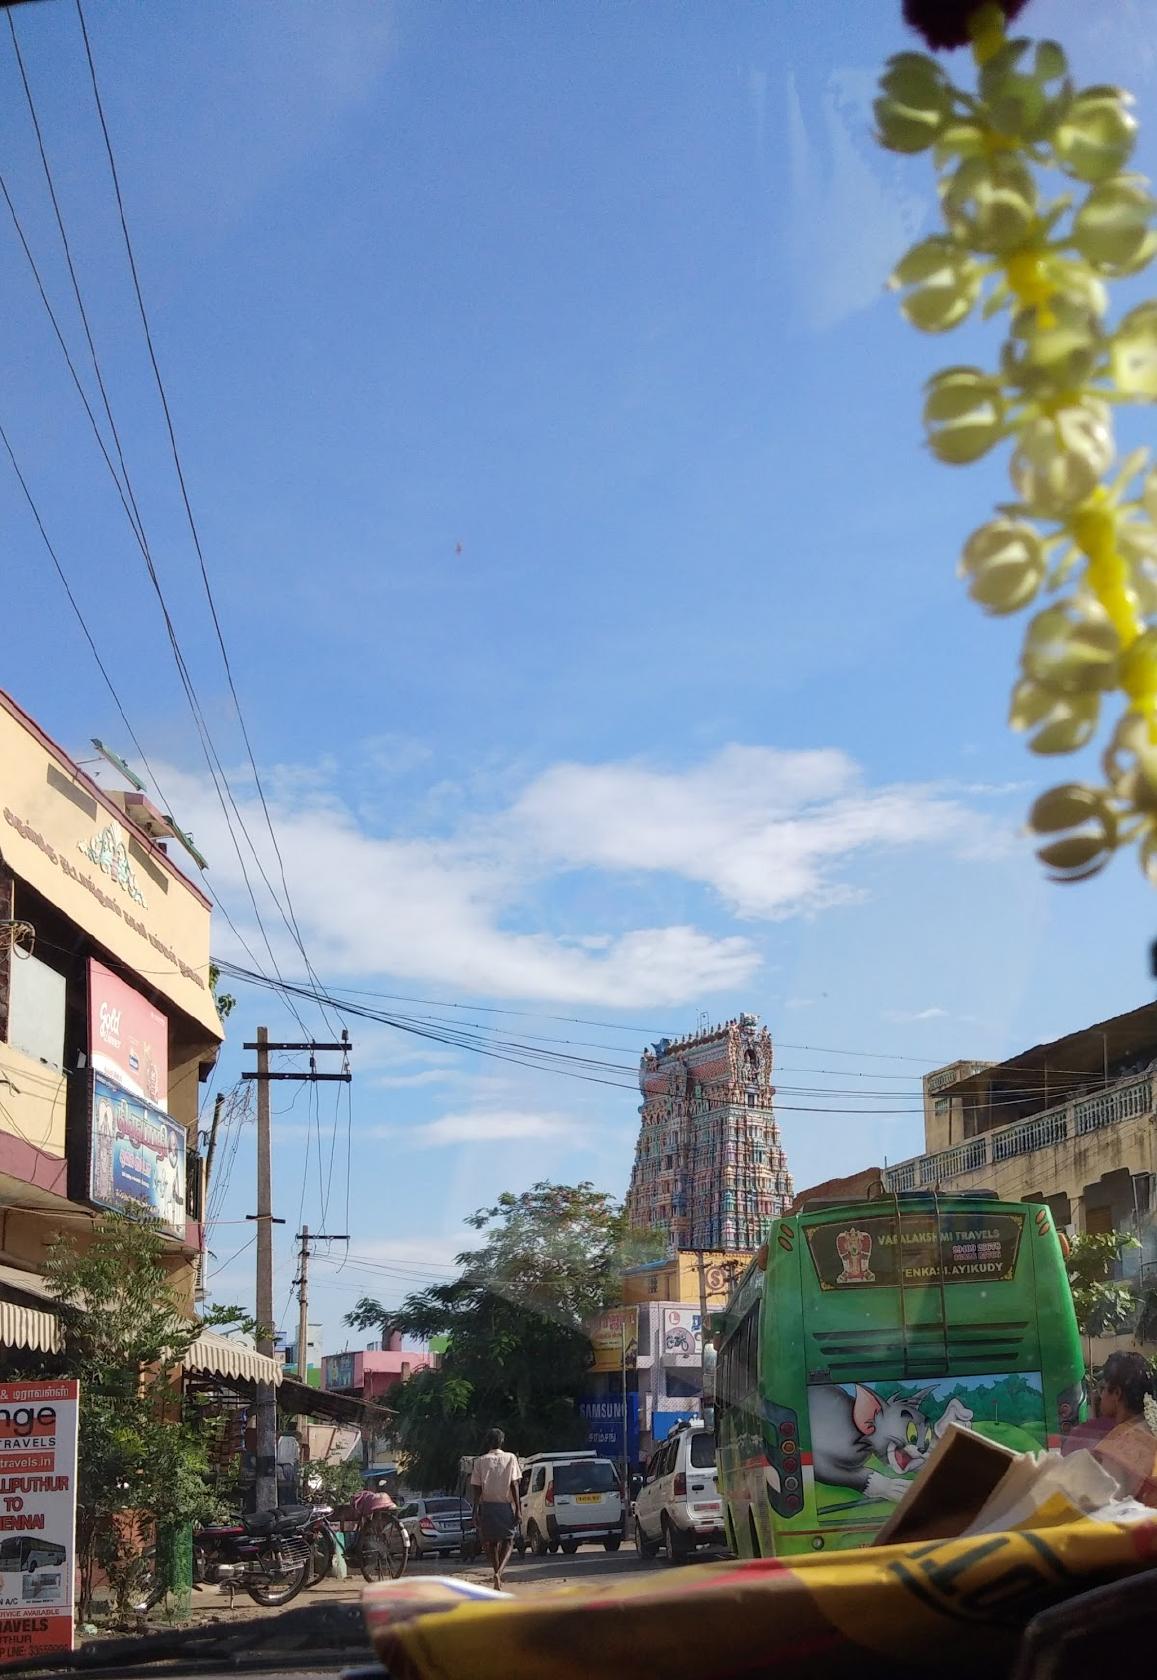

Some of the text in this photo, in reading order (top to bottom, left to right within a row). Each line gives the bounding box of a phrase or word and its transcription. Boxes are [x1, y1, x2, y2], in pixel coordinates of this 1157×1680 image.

[955, 1229, 1000, 1241] TRAVELS
[952, 1263, 1003, 1275] AYIKUDY
[1, 1389, 9, 1400] &
[3, 1496, 23, 1512] TO
[22, 1608, 60, 1617] AVAILABLE
